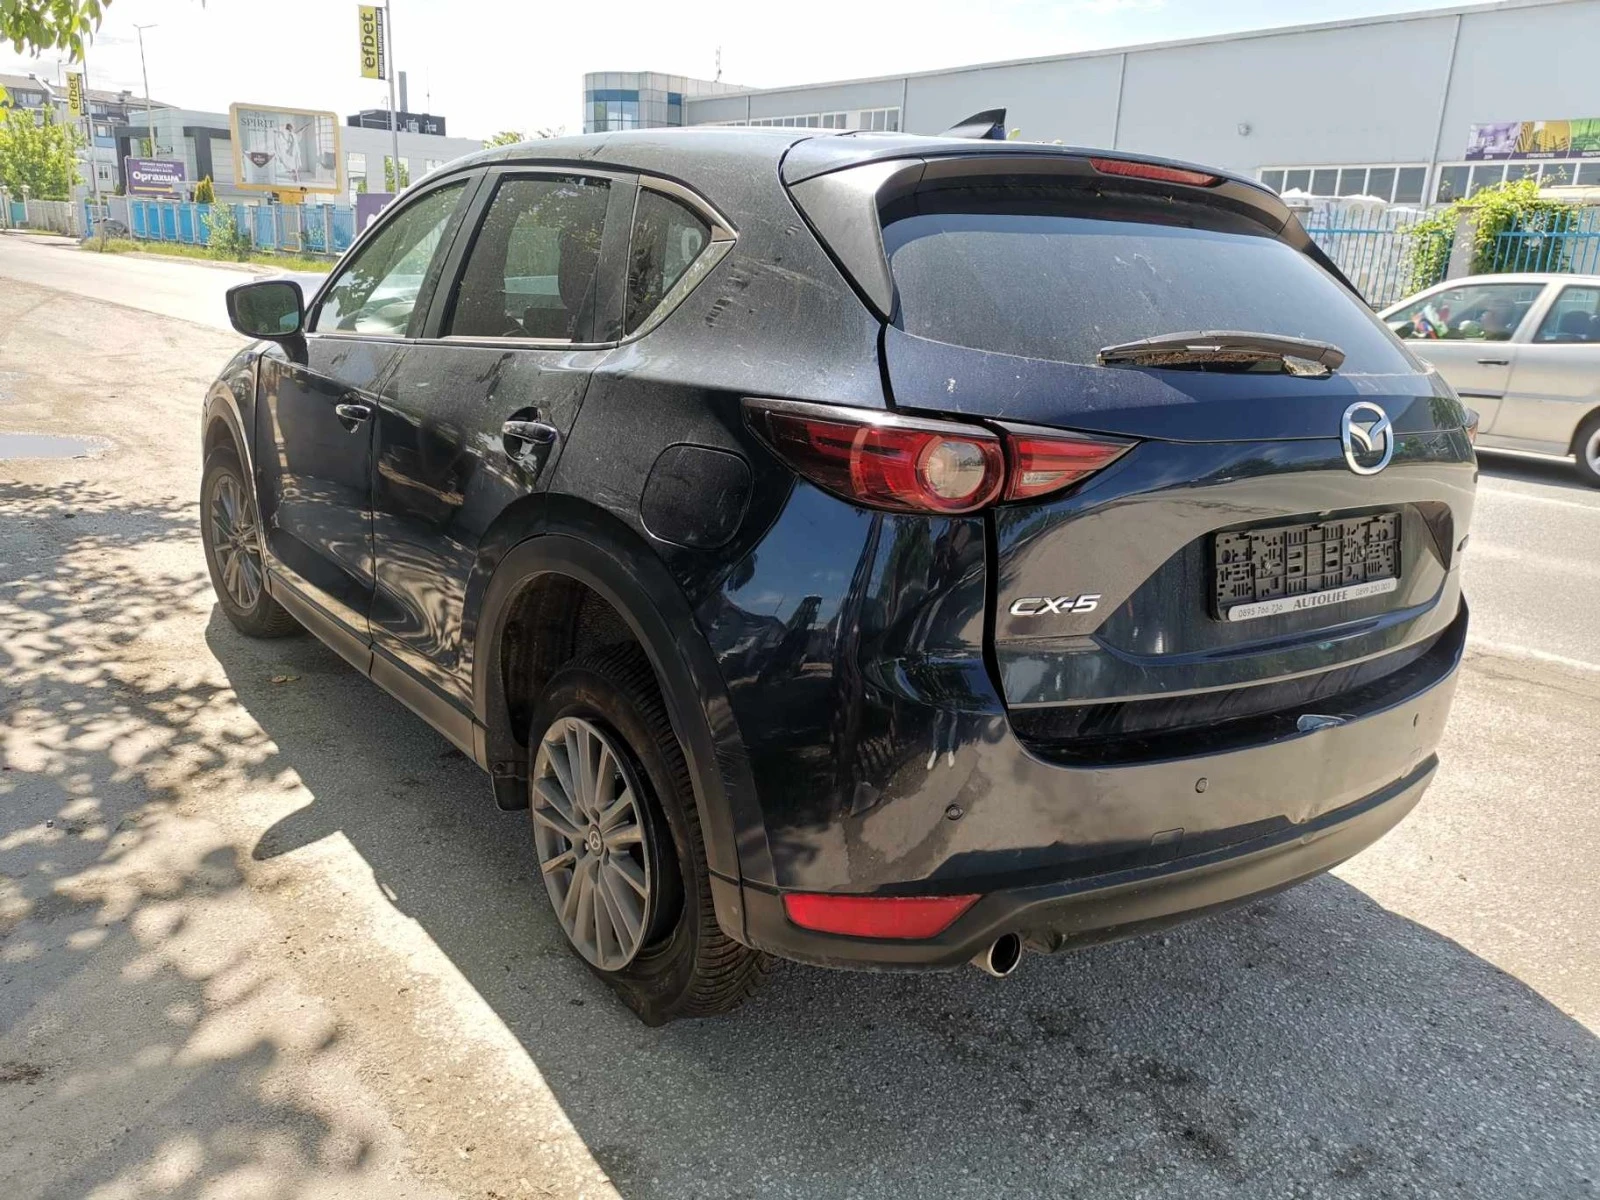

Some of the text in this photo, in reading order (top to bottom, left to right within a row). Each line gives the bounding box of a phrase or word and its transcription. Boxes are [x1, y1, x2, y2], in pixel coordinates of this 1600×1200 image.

[361, 13, 376, 69] efbet
[69, 76, 79, 110] efbet
[241, 117, 275, 129] SPIRIT
[1009, 594, 1102, 616] CX-5
[1293, 589, 1348, 610] AUTOLIFE
